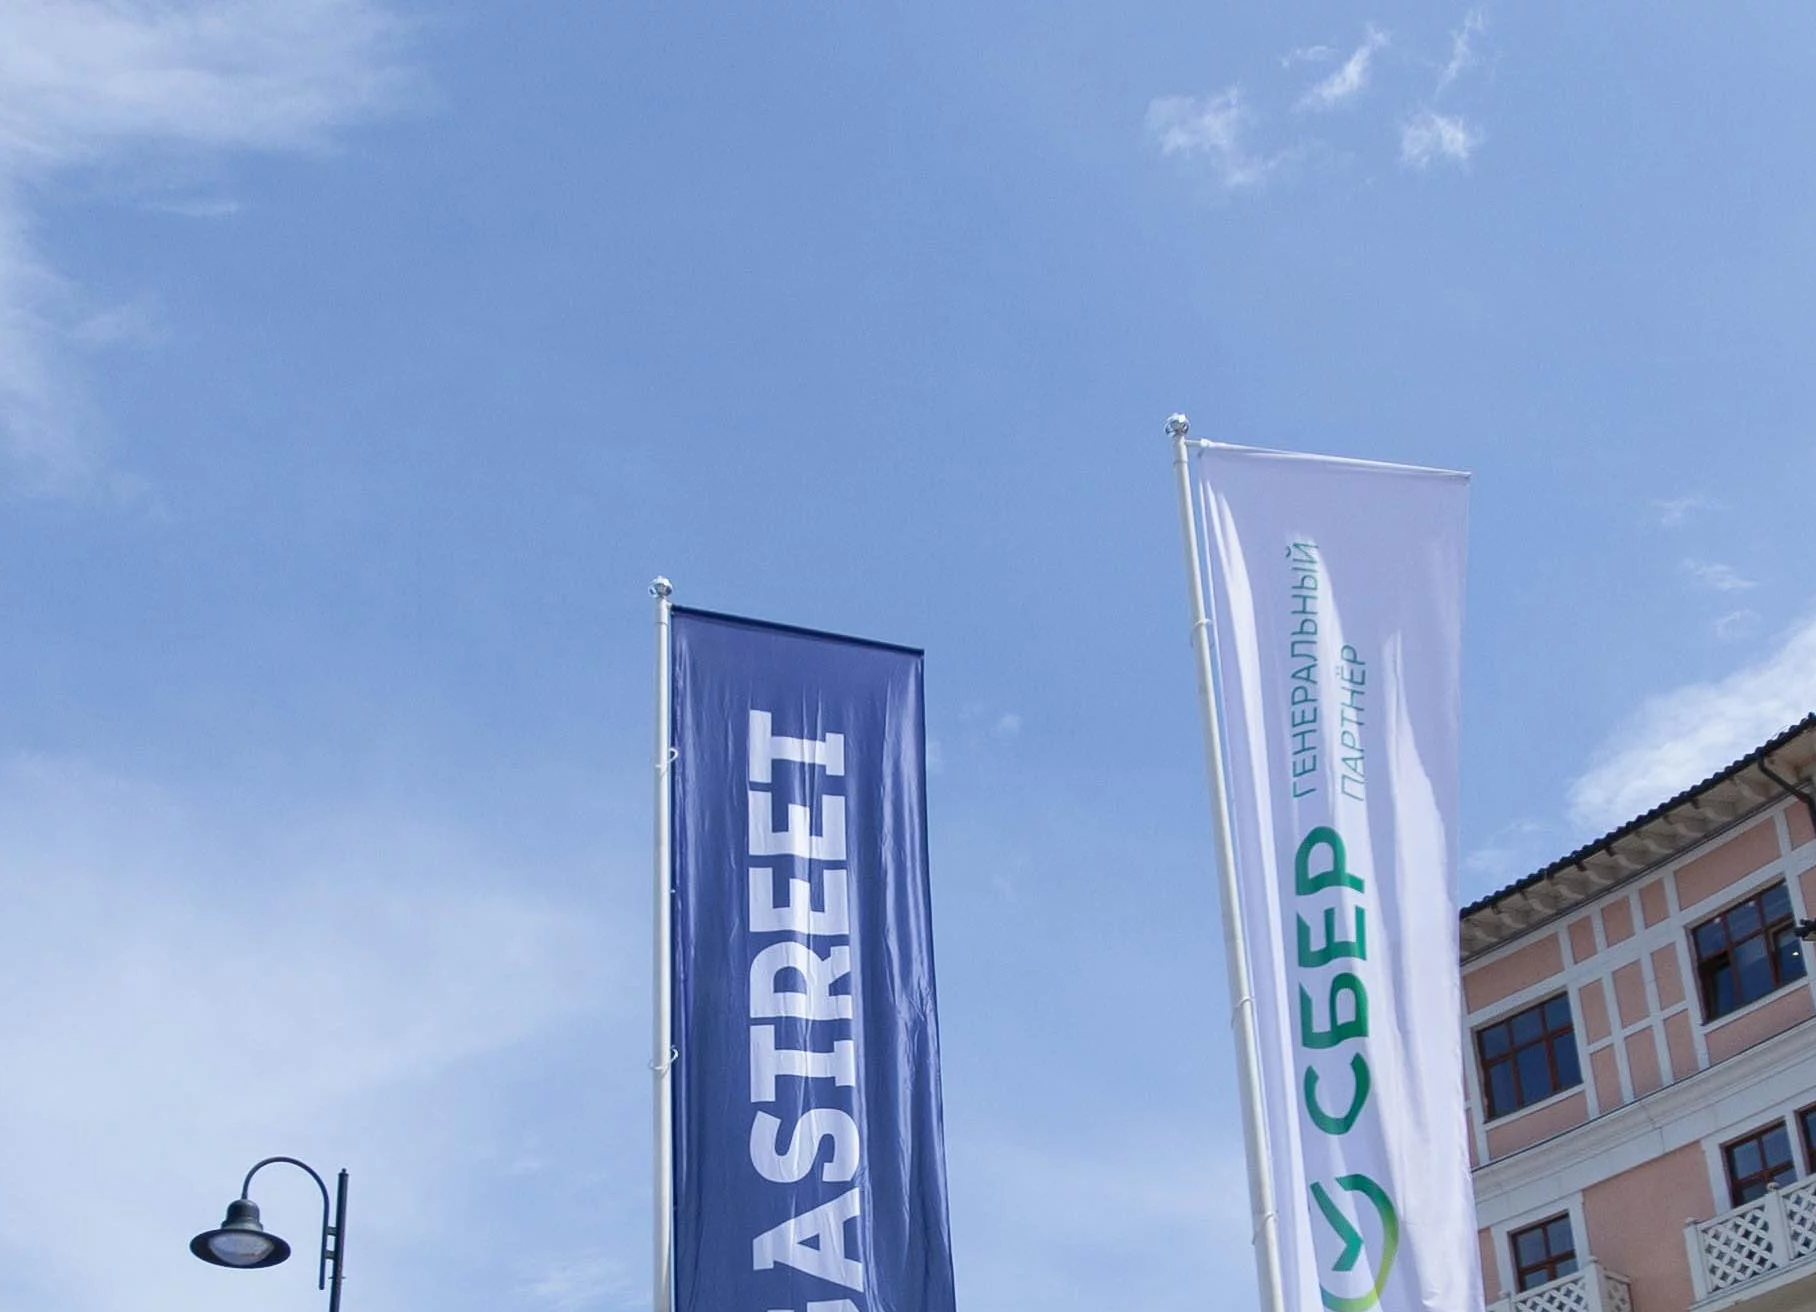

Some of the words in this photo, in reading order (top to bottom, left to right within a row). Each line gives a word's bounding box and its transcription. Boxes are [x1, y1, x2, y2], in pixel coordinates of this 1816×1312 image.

[1285, 541, 1320, 798] ГЕНЕРАЛЬНЫЙ
[1334, 643, 1368, 802] ПАРТНЁР
[1294, 824, 1372, 1136] СБЕР
